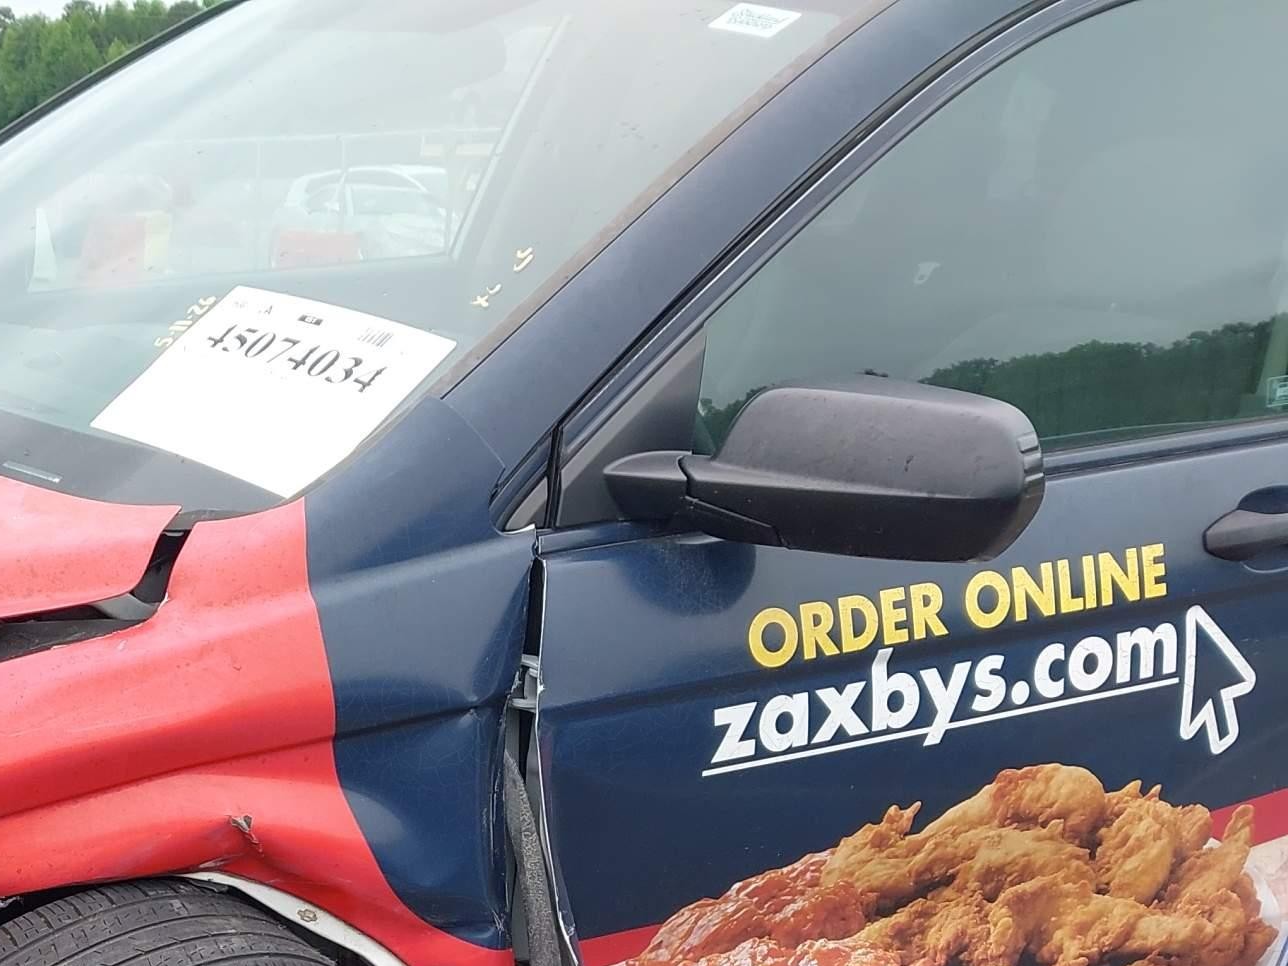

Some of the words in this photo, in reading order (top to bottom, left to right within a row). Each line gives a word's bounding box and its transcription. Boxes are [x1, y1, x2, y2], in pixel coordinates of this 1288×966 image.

[207, 324, 388, 393] 45074034
[748, 582, 950, 668] ORDER
[965, 543, 1168, 629] ONLINE
[710, 622, 1178, 764] zaxbys.com
